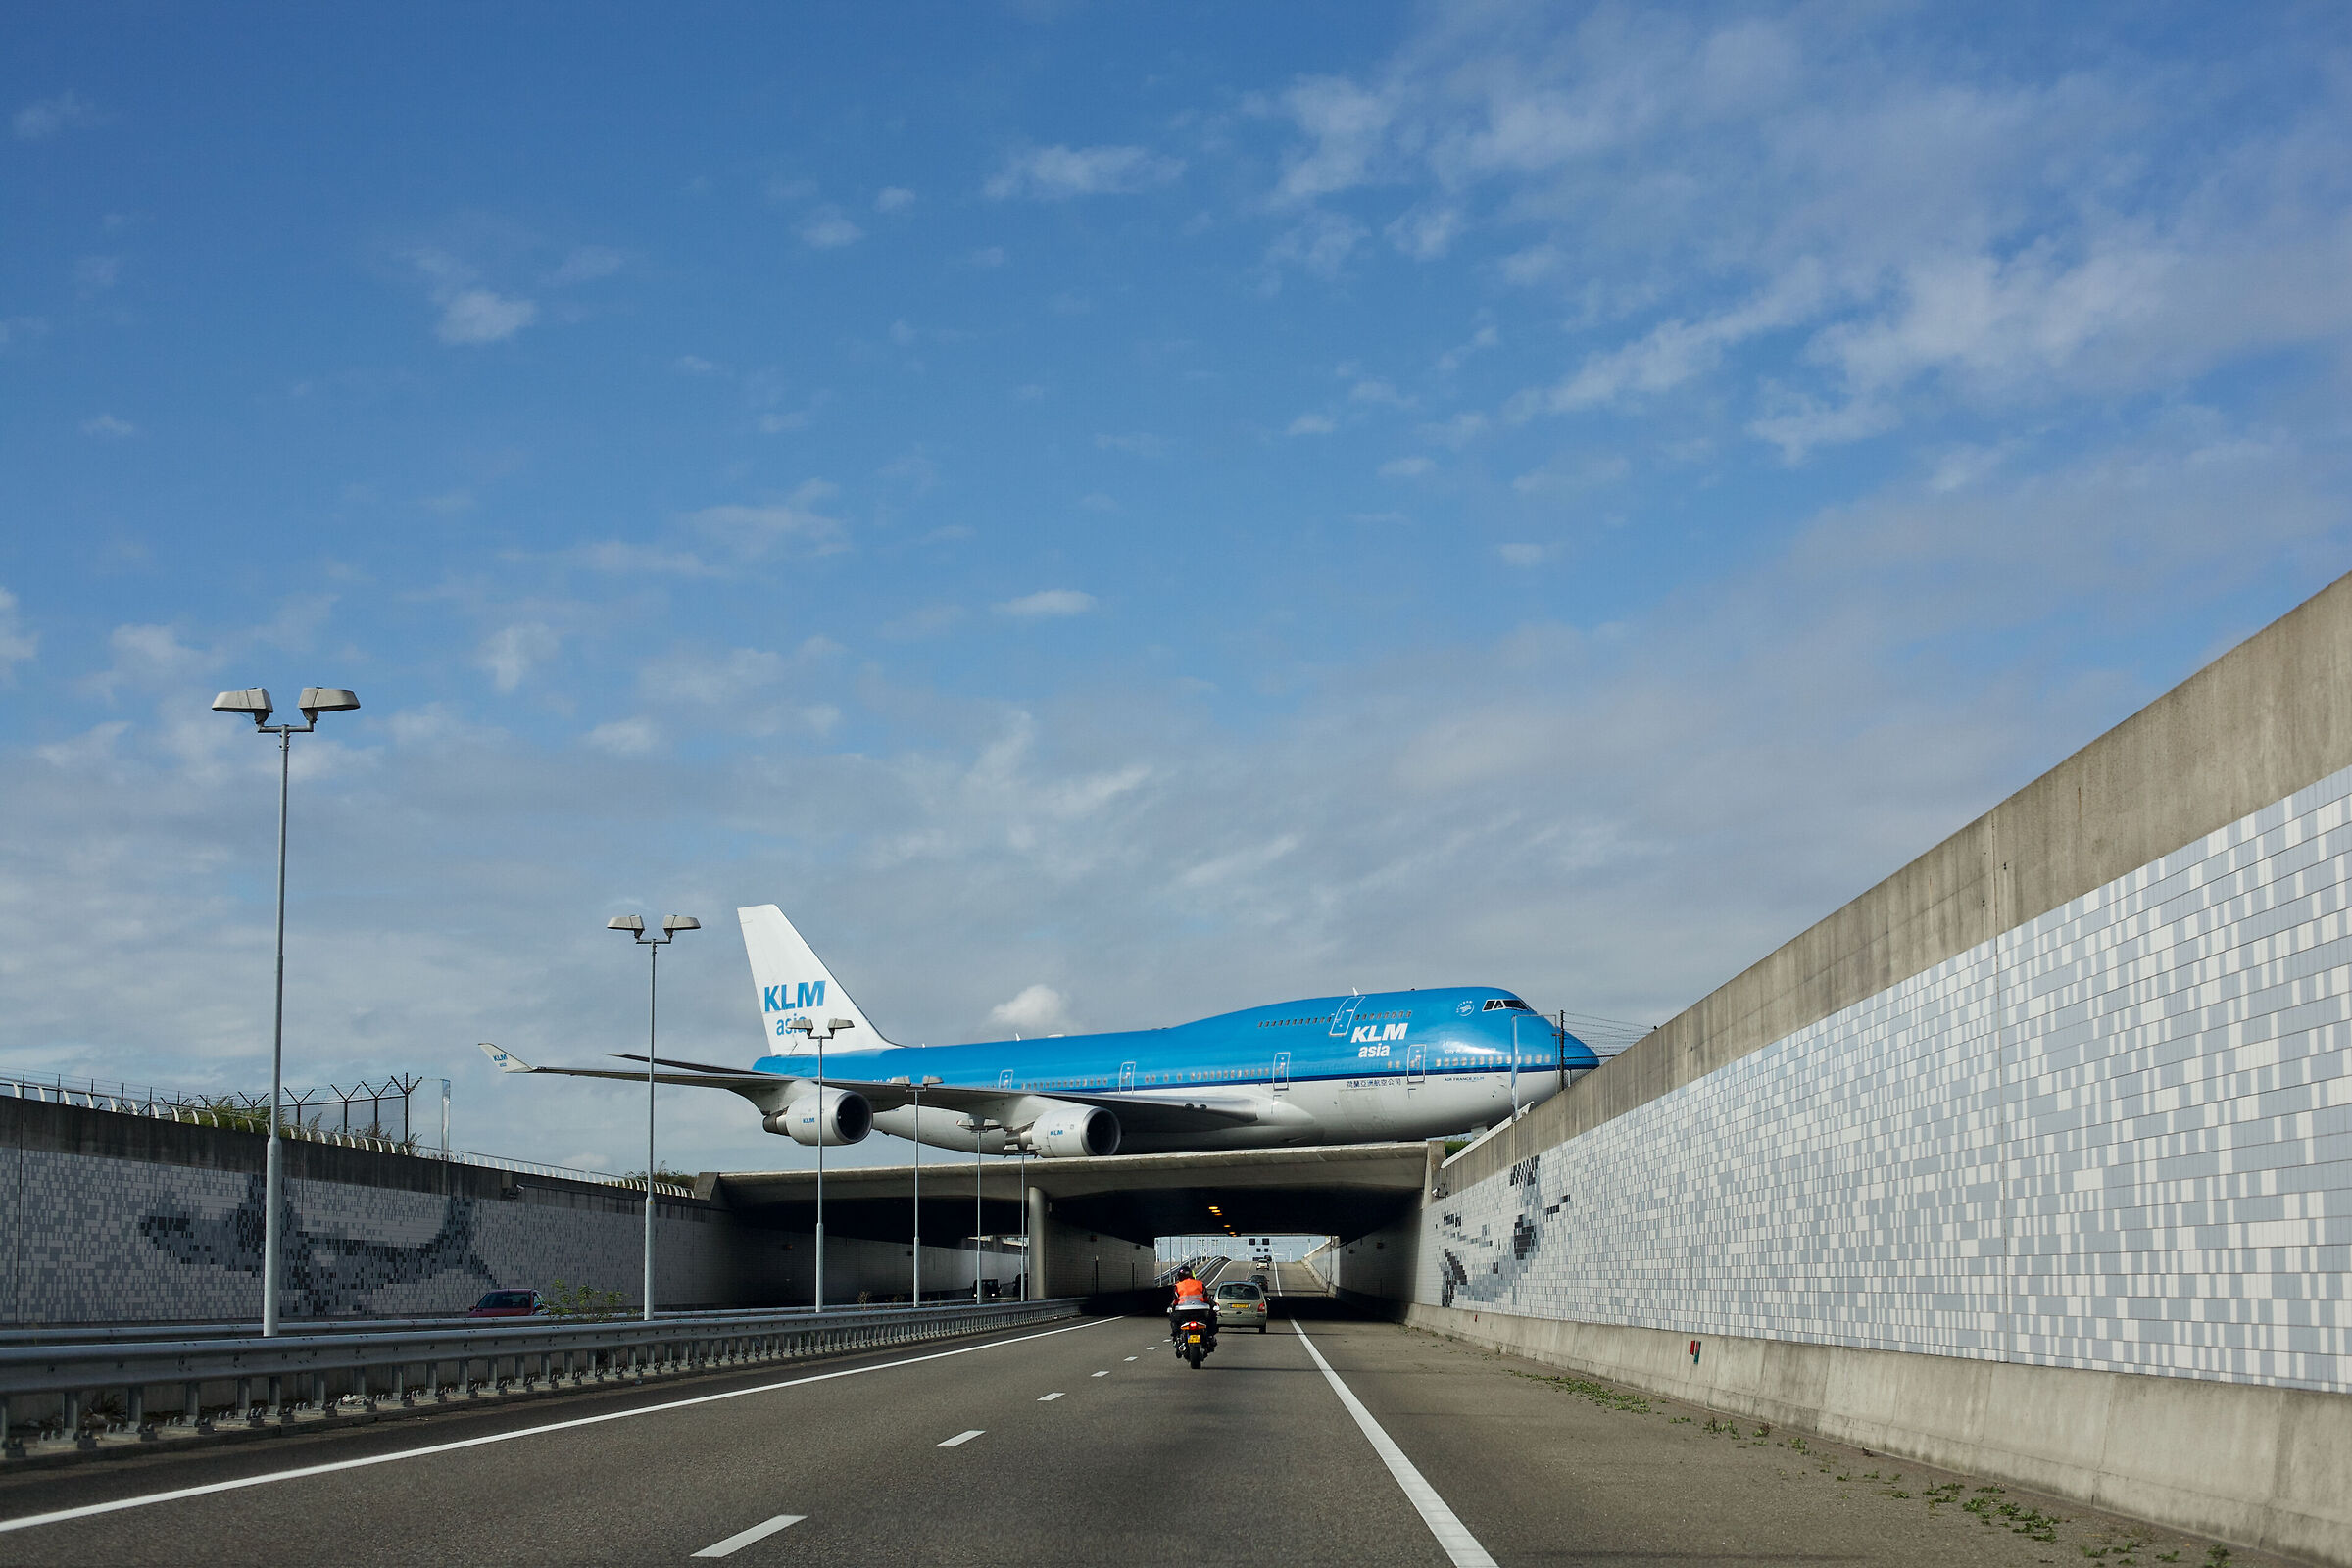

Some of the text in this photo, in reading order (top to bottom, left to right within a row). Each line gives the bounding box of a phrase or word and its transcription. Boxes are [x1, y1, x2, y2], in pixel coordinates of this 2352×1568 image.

[764, 980, 826, 1012] KLM
[1350, 1023, 1408, 1043] KLM
[1358, 1043, 1391, 1058] asia
